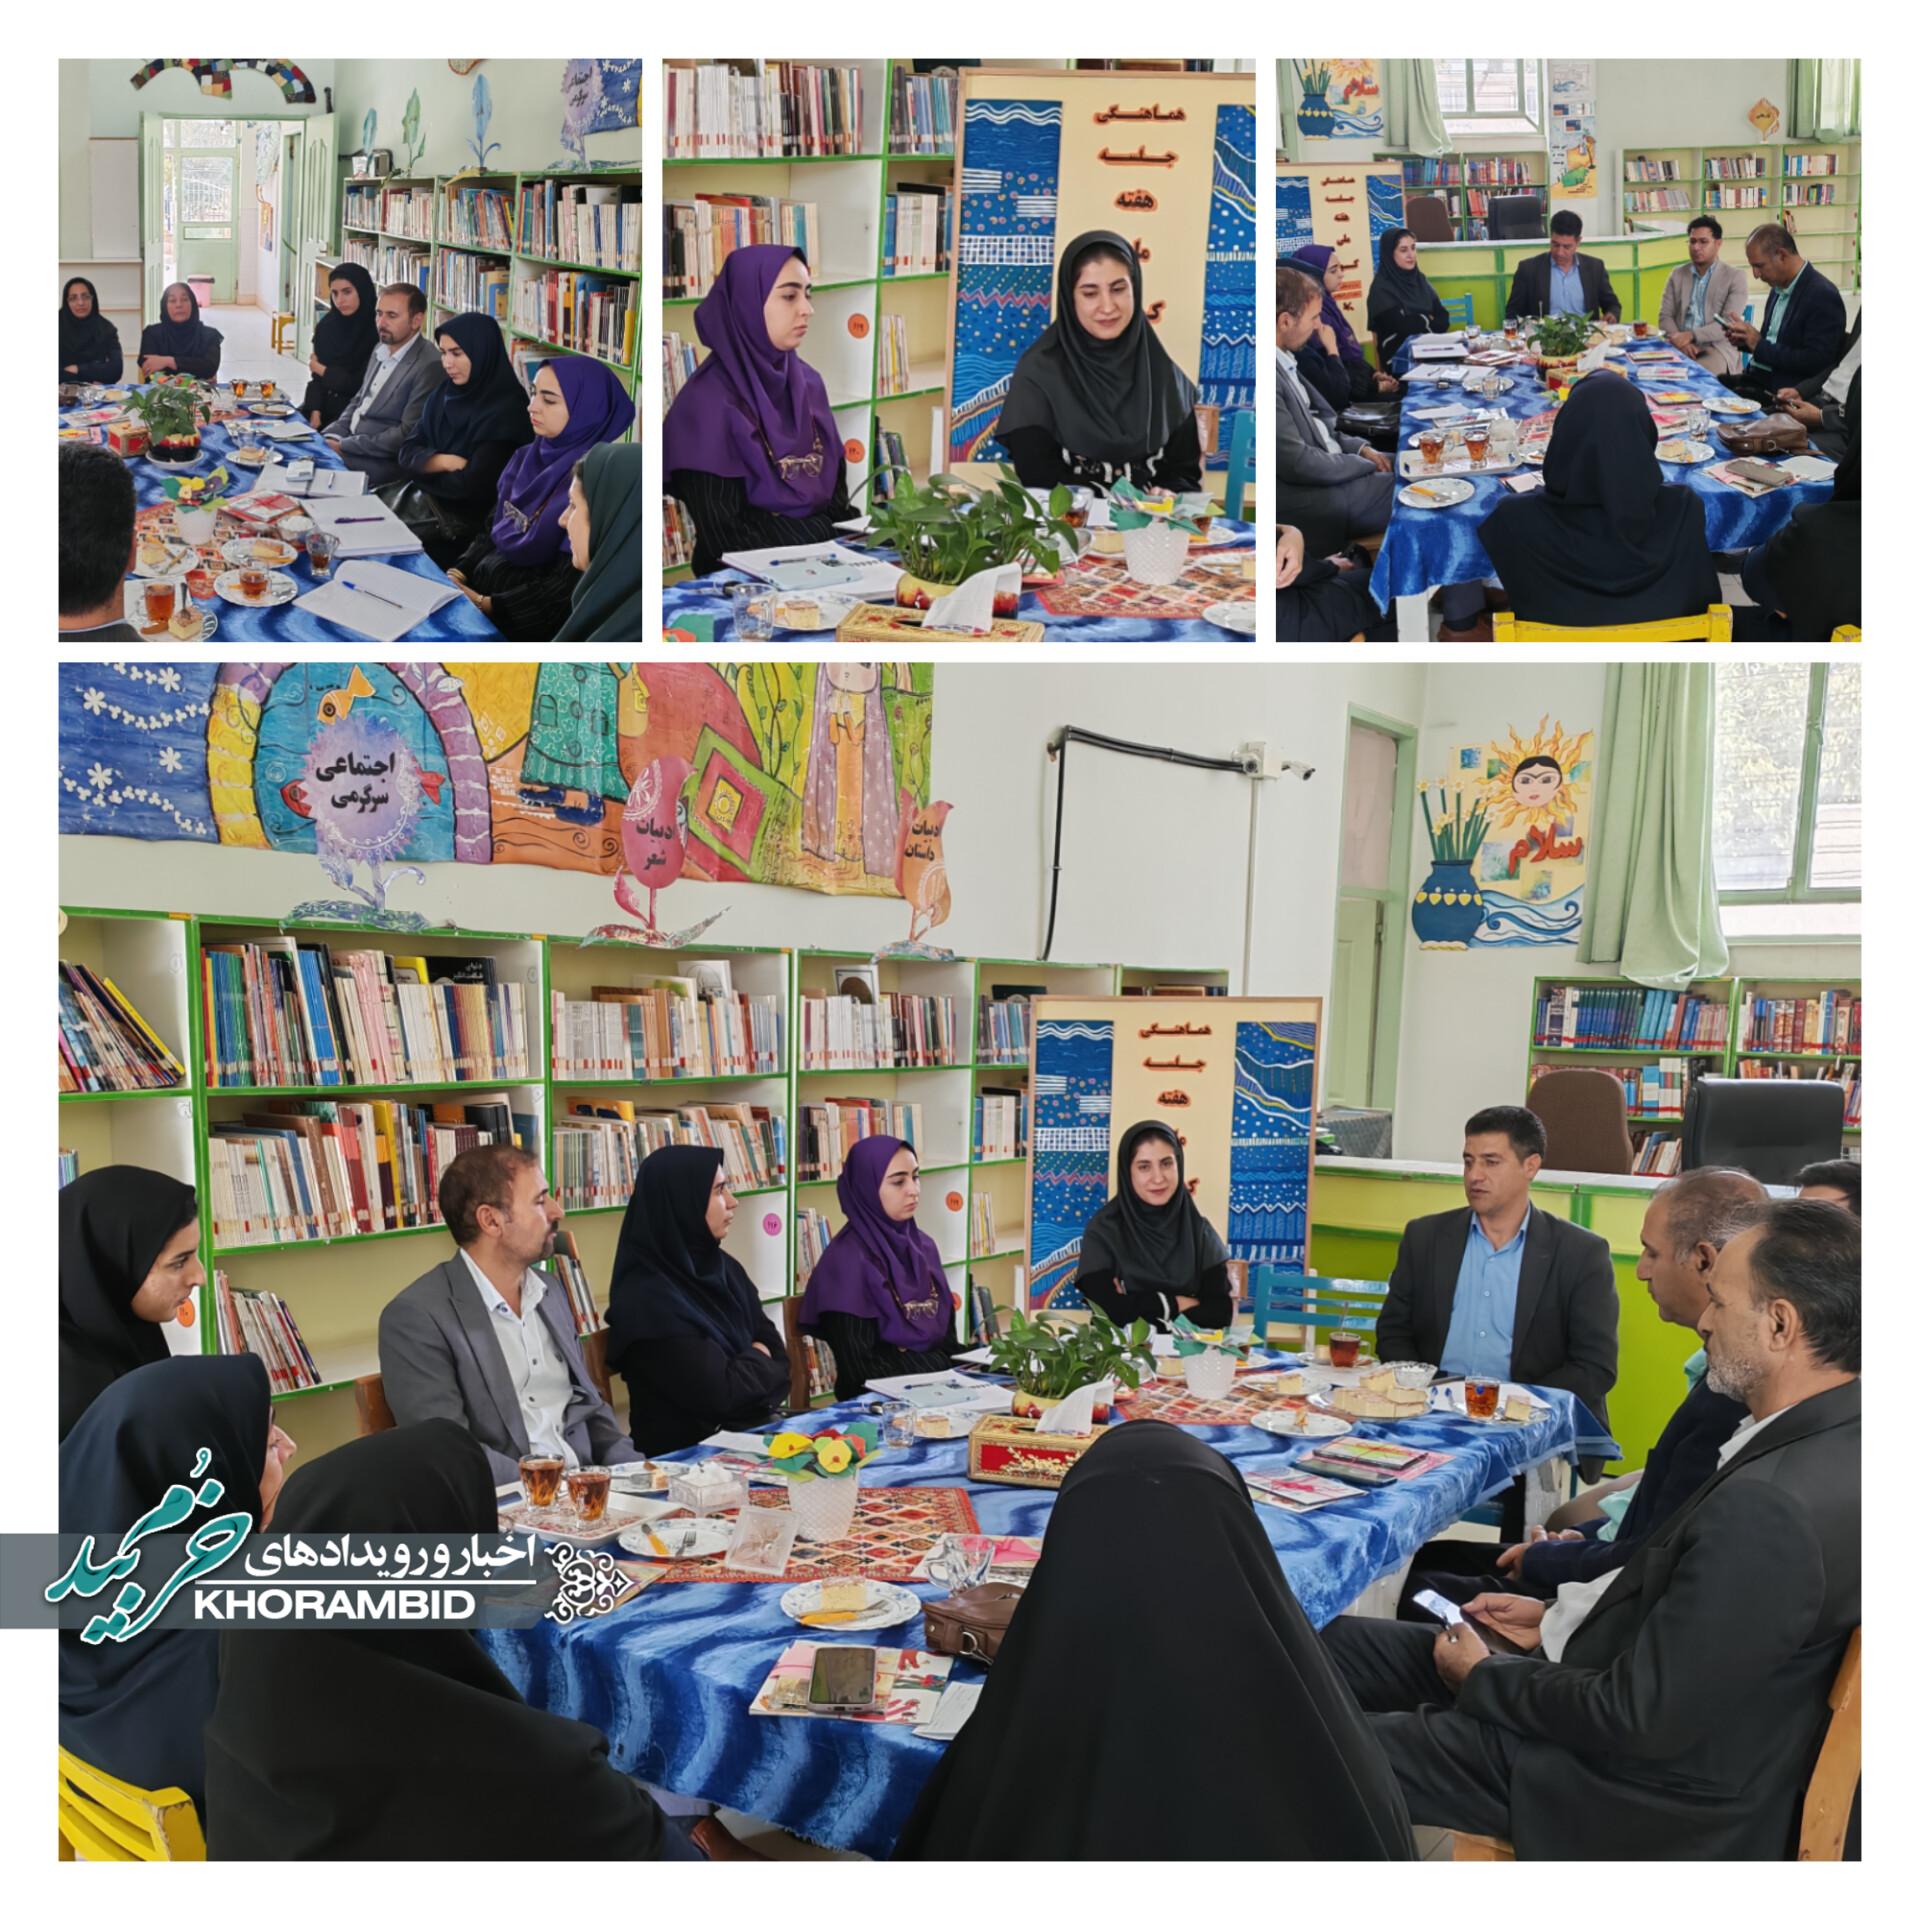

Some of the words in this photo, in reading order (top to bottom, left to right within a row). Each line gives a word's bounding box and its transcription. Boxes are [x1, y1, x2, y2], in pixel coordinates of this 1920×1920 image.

[1095, 103, 1185, 124] هماهنگی
[1099, 145, 1177, 168] جلسه
[1115, 189, 1155, 209] هفته
[316, 752, 395, 783] اجتماعی
[331, 784, 389, 813] سرگرمی
[643, 849, 667, 870] شعر
[904, 843, 935, 861] داستان
[1508, 822, 1583, 877] سلام
[1139, 1022, 1212, 1039] هماهنگی
[1143, 1055, 1207, 1072] جلسه
[1158, 1090, 1190, 1106] هفته
